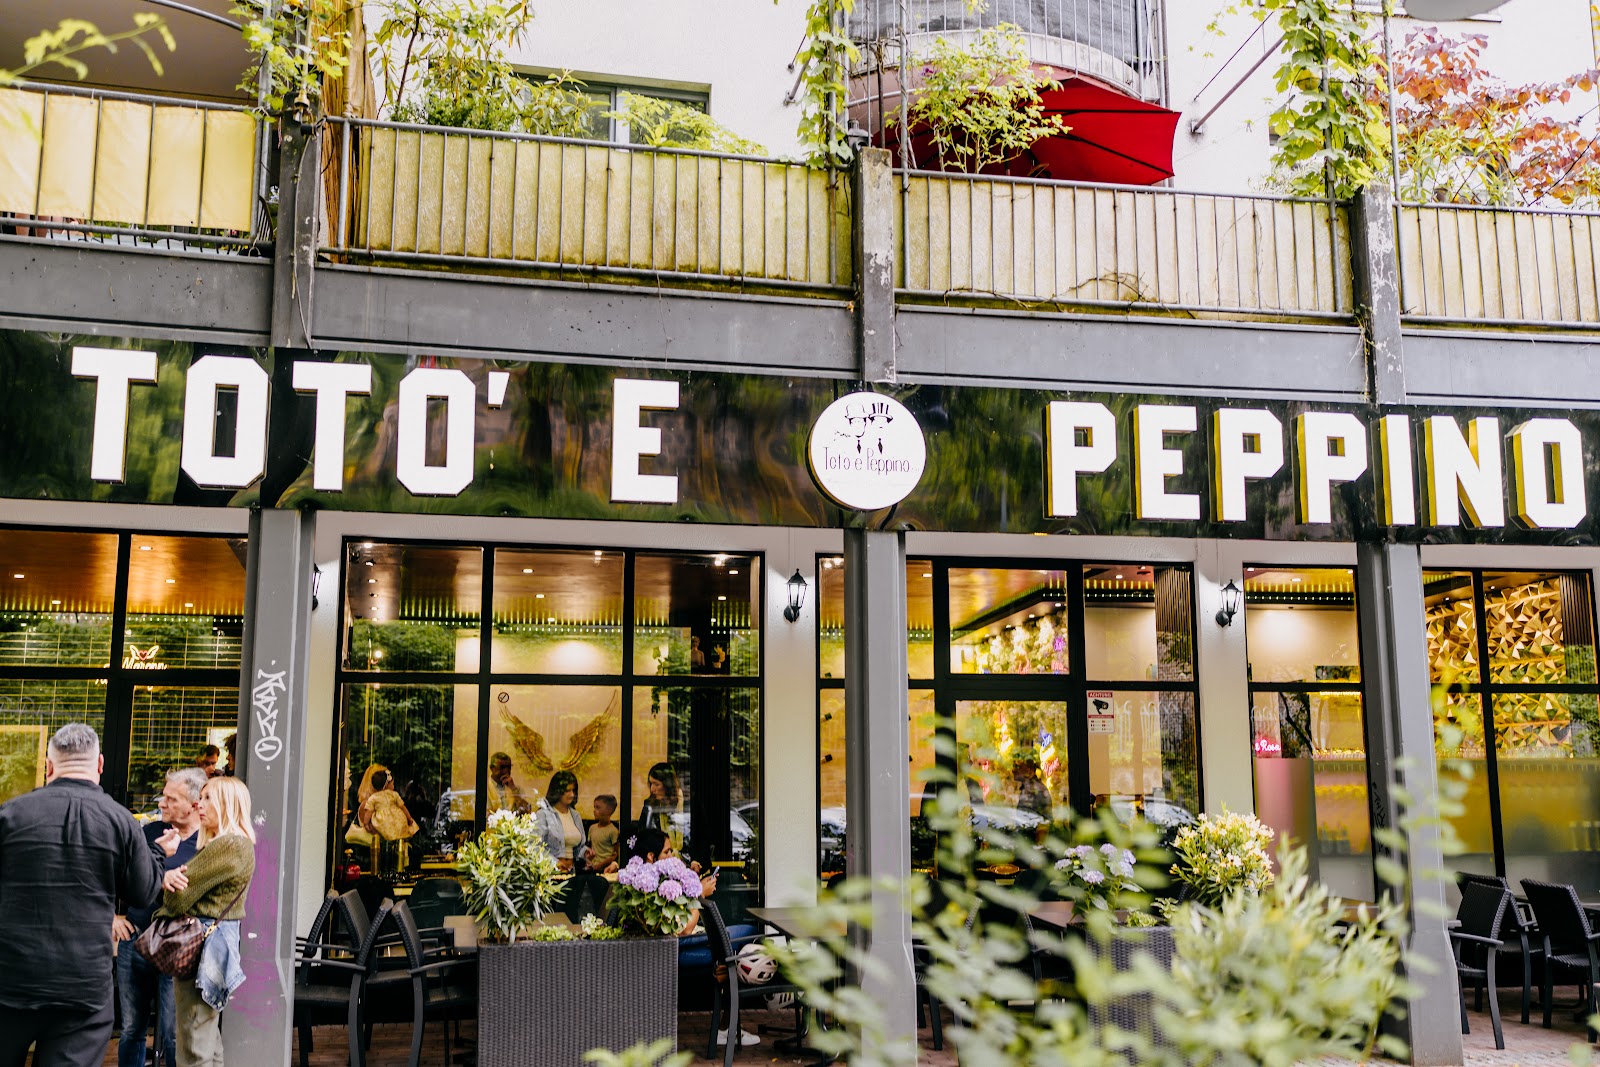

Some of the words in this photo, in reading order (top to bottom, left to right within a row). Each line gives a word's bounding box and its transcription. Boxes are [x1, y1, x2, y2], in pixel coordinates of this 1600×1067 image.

[71, 346, 510, 496] TOTO'
[610, 378, 680, 503] E
[1045, 401, 1587, 529] PEPPINO
[854, 457, 863, 471] e
[866, 447, 910, 476] Peppino
